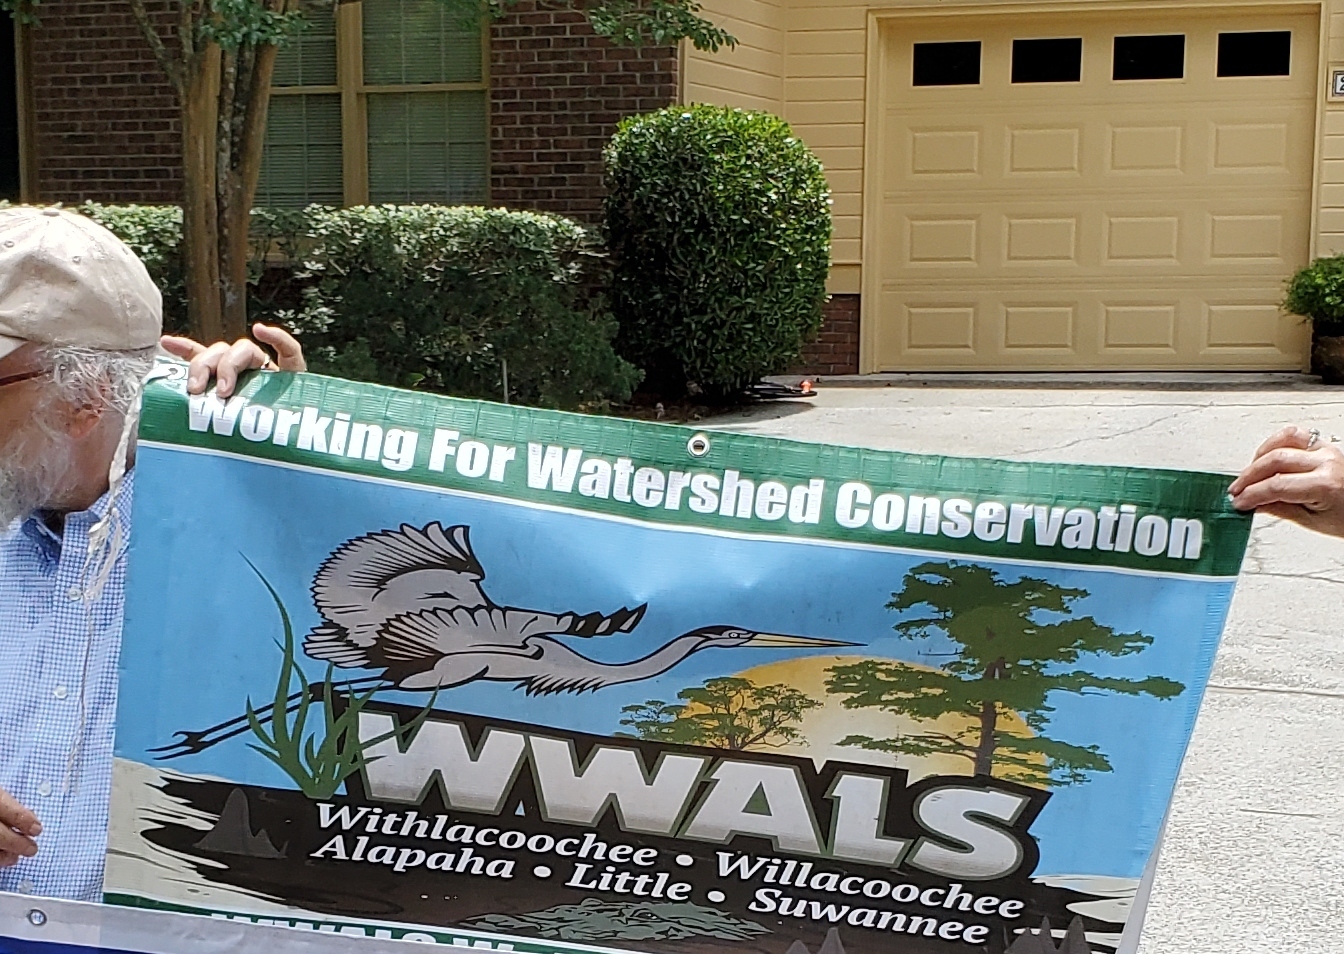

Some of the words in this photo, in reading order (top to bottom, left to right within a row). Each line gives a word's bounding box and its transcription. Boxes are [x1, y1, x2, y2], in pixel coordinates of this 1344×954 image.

[187, 393, 419, 472] Working
[427, 427, 516, 483] For
[526, 441, 825, 525] Watershed
[834, 481, 1204, 560] Conservation
[315, 802, 659, 867] Withlacoochee
[715, 851, 1026, 920] Willacoochee
[356, 709, 1032, 881] WWALS
[310, 834, 516, 879] Alapaha
[565, 862, 692, 901] Little
[748, 887, 990, 945] Suwannee
